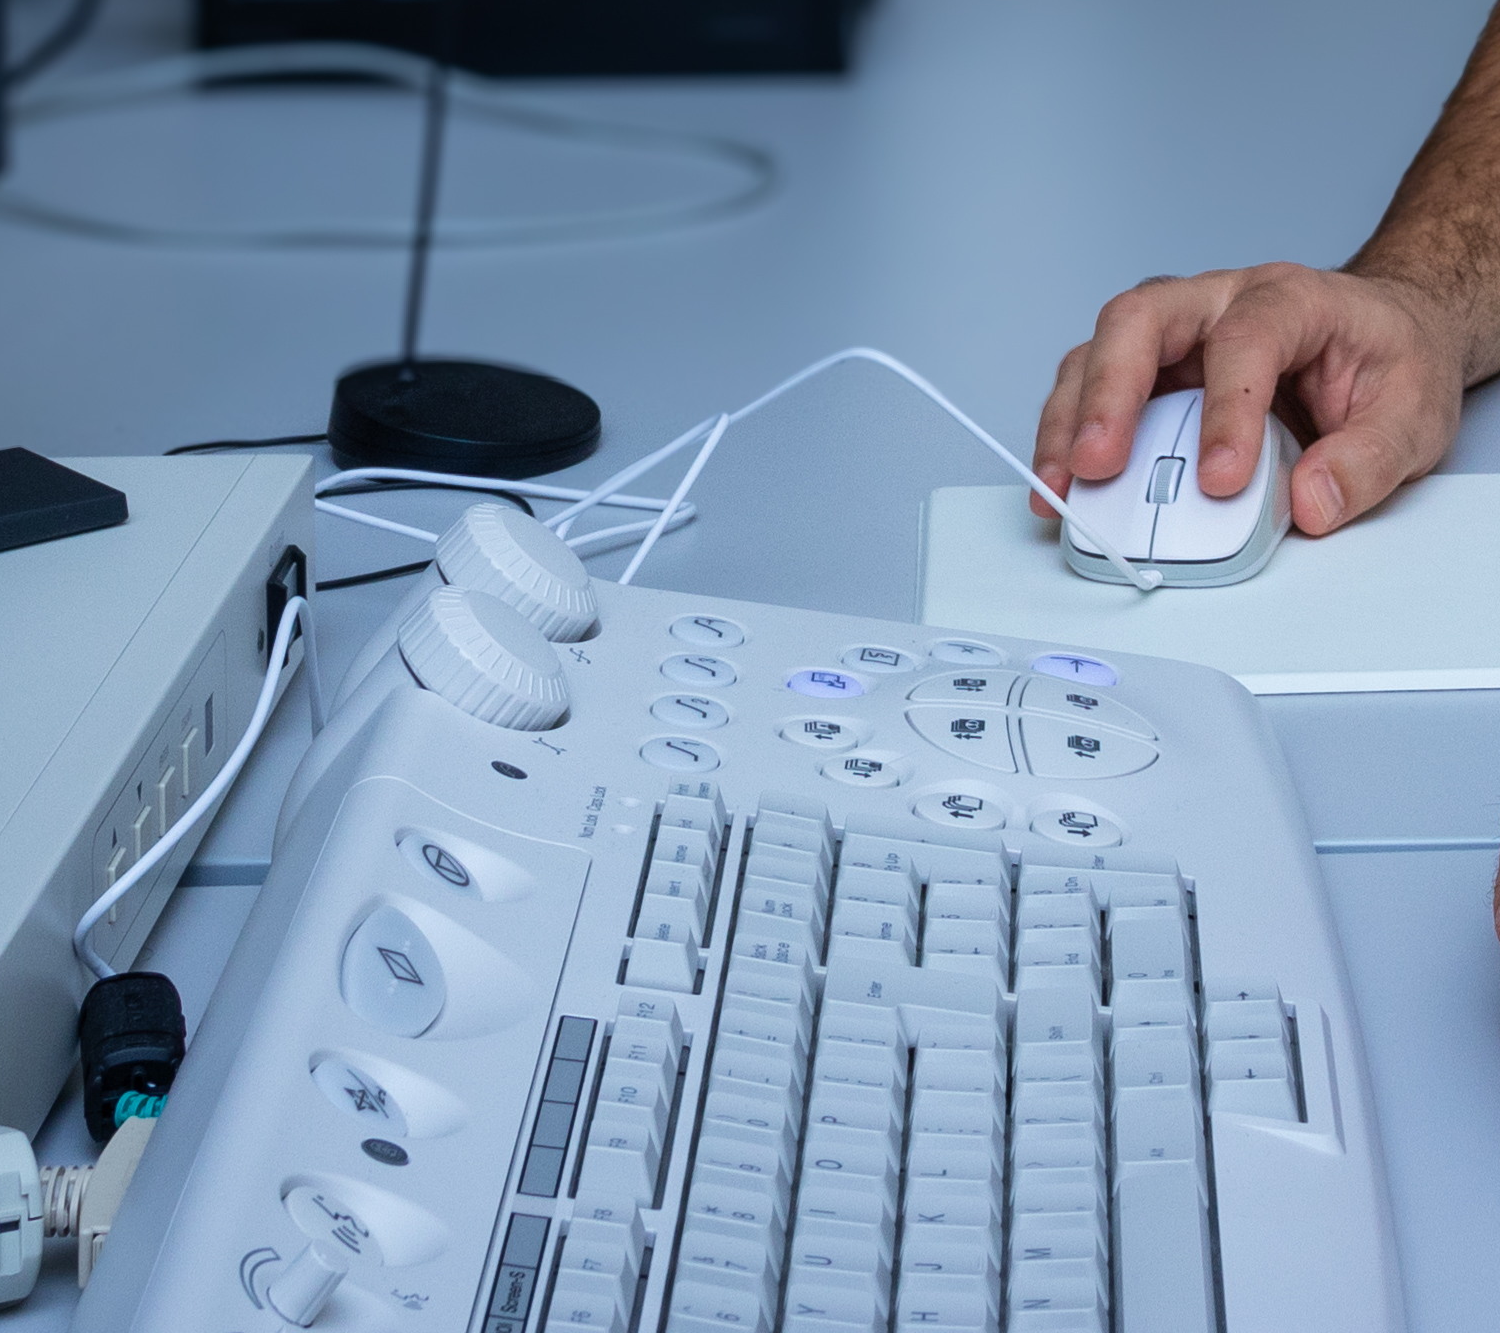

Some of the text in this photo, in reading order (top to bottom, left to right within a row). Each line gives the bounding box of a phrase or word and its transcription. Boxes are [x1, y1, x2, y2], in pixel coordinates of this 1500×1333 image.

[582, 813, 599, 826] Lock
[866, 981, 882, 999] Enter
[627, 1044, 648, 1059] F11
[618, 1086, 638, 1102] F10
[821, 1115, 846, 1125] P
[815, 1159, 843, 1170] O
[919, 1213, 945, 1223] K
[1024, 1247, 1052, 1260] M
[582, 1258, 602, 1271] F7
[804, 1255, 832, 1266] U
[914, 1262, 943, 1271] J
[500, 1271, 525, 1313] Screen-S
[797, 1303, 825, 1316] Y
[1022, 1299, 1050, 1309] N
[911, 1311, 939, 1323] H
